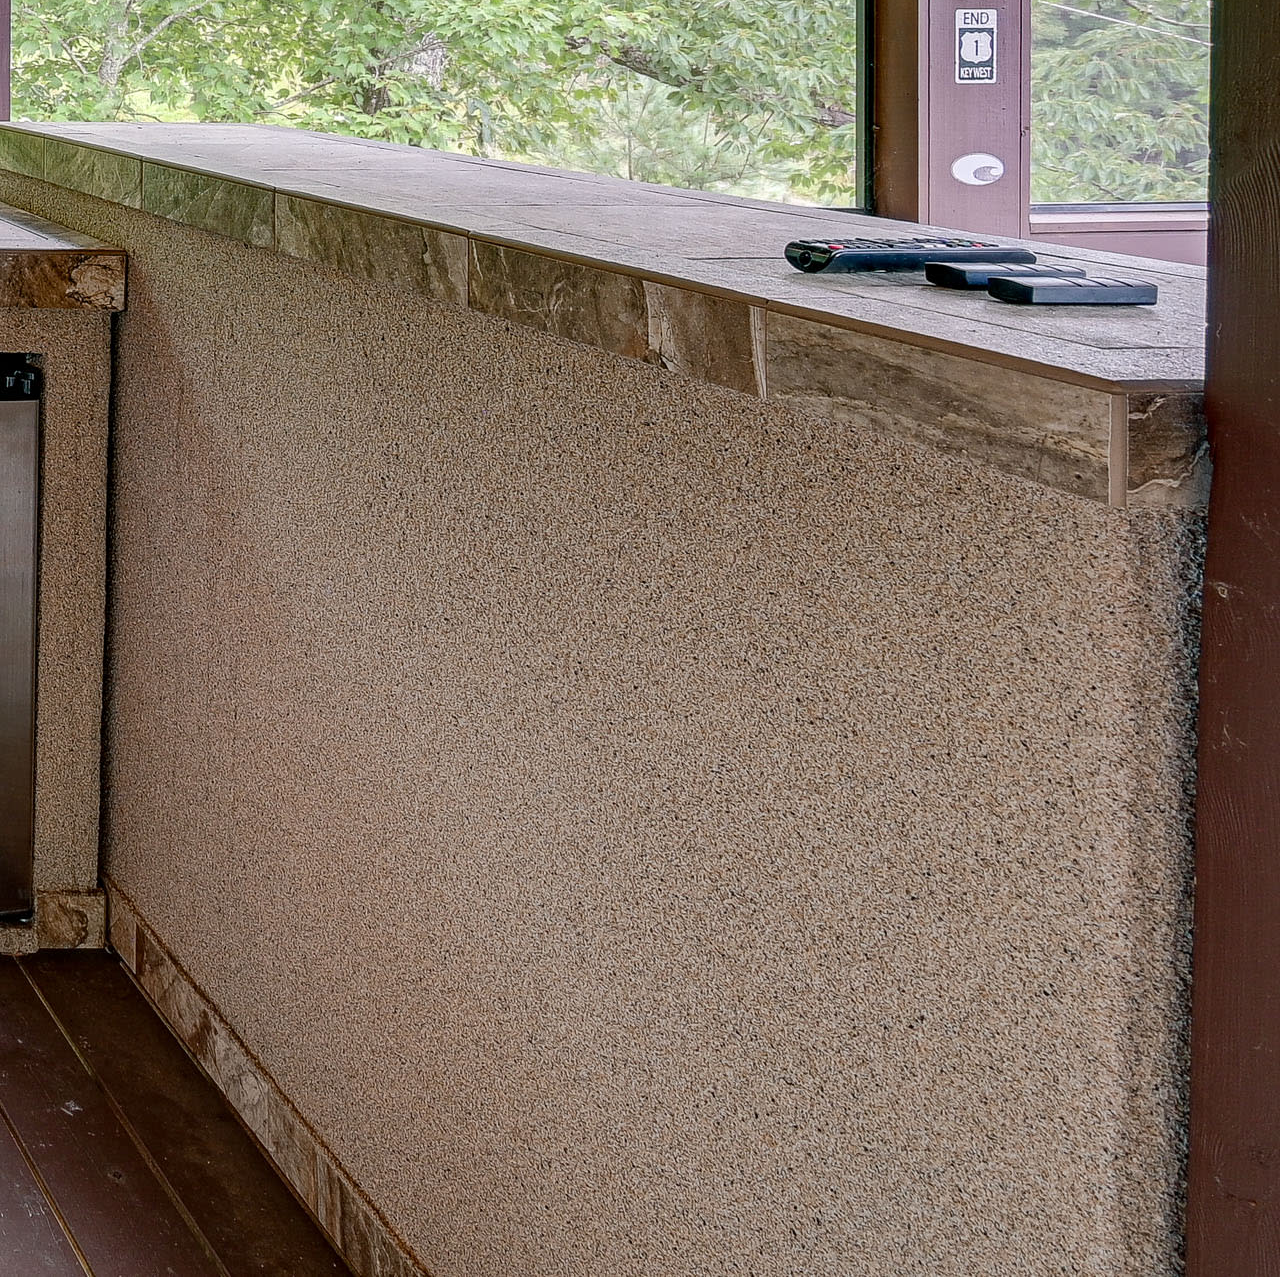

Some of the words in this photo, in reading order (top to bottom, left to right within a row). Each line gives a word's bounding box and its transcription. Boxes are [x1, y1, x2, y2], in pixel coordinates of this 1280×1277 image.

[963, 12, 990, 25] END
[974, 39, 979, 56] 1
[960, 67, 973, 78] KEY
[972, 67, 992, 78] WEST
